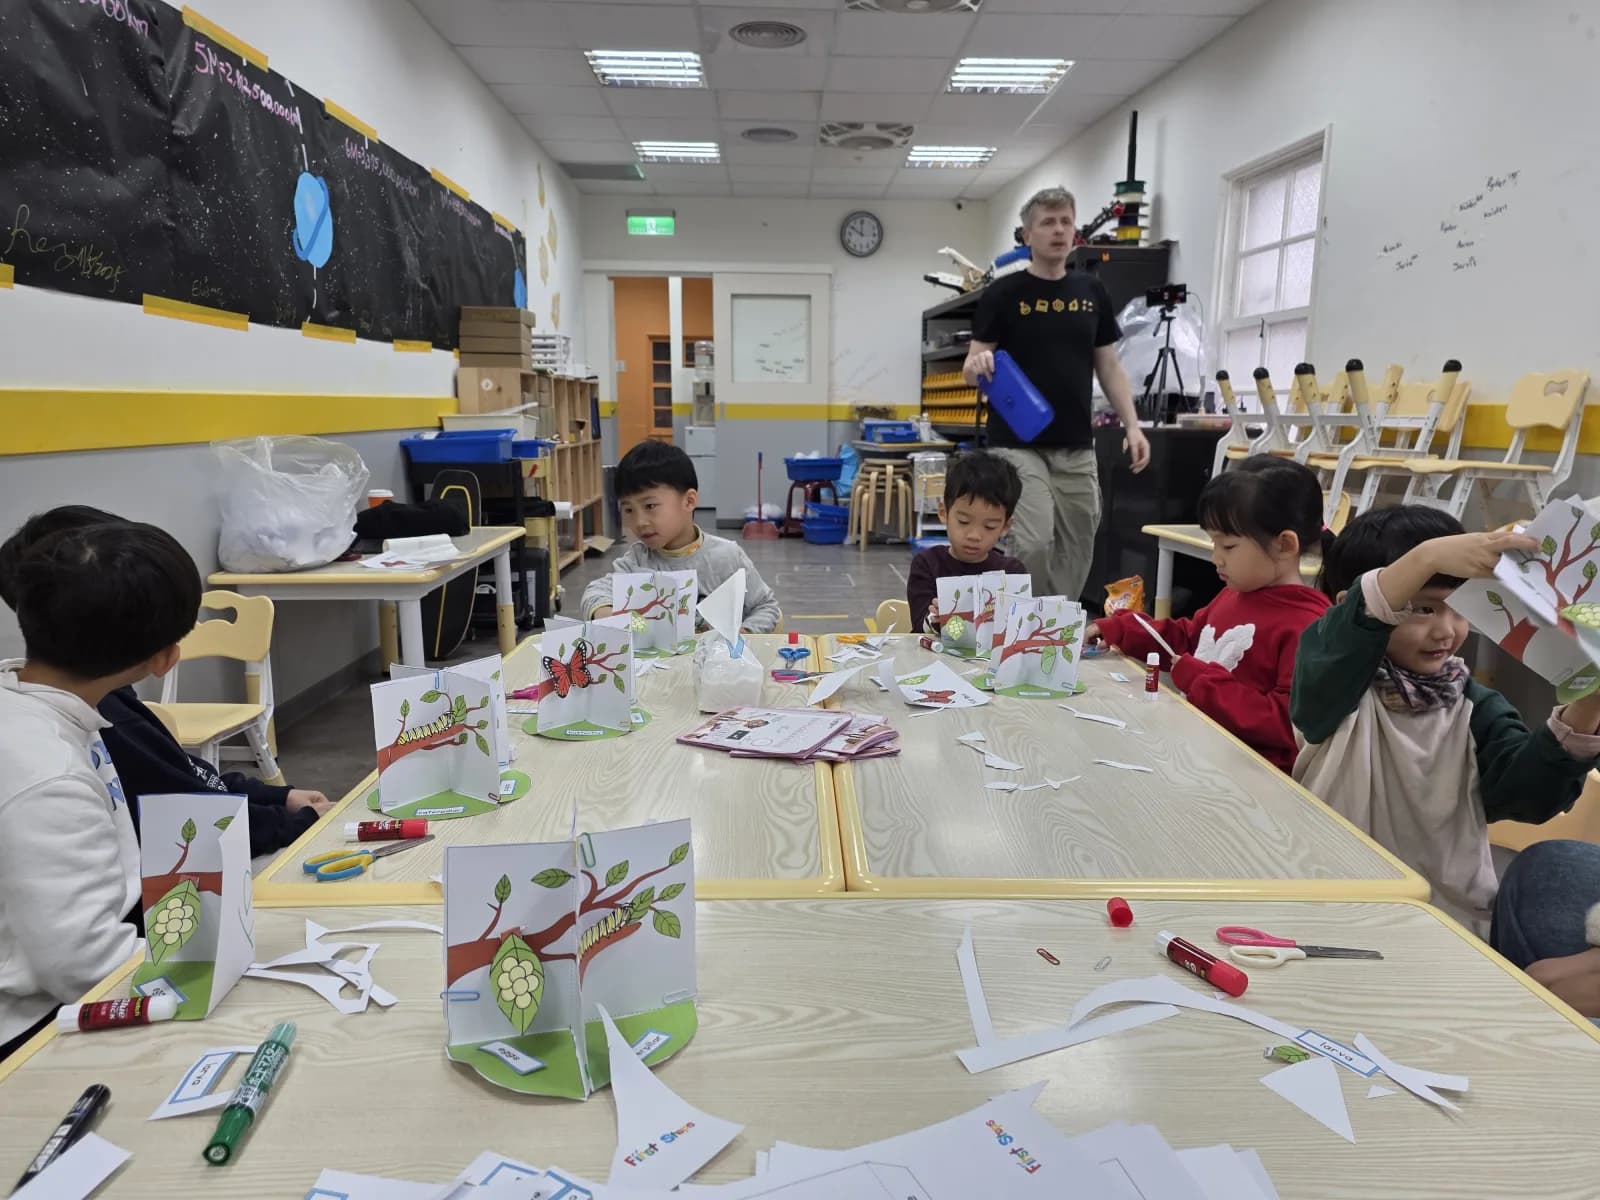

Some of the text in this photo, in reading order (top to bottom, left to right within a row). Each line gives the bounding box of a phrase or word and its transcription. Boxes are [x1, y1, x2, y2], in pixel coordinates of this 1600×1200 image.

[1319, 1039, 1354, 1064] larva
[624, 1142, 659, 1168] First
[1009, 1146, 1042, 1174] First
